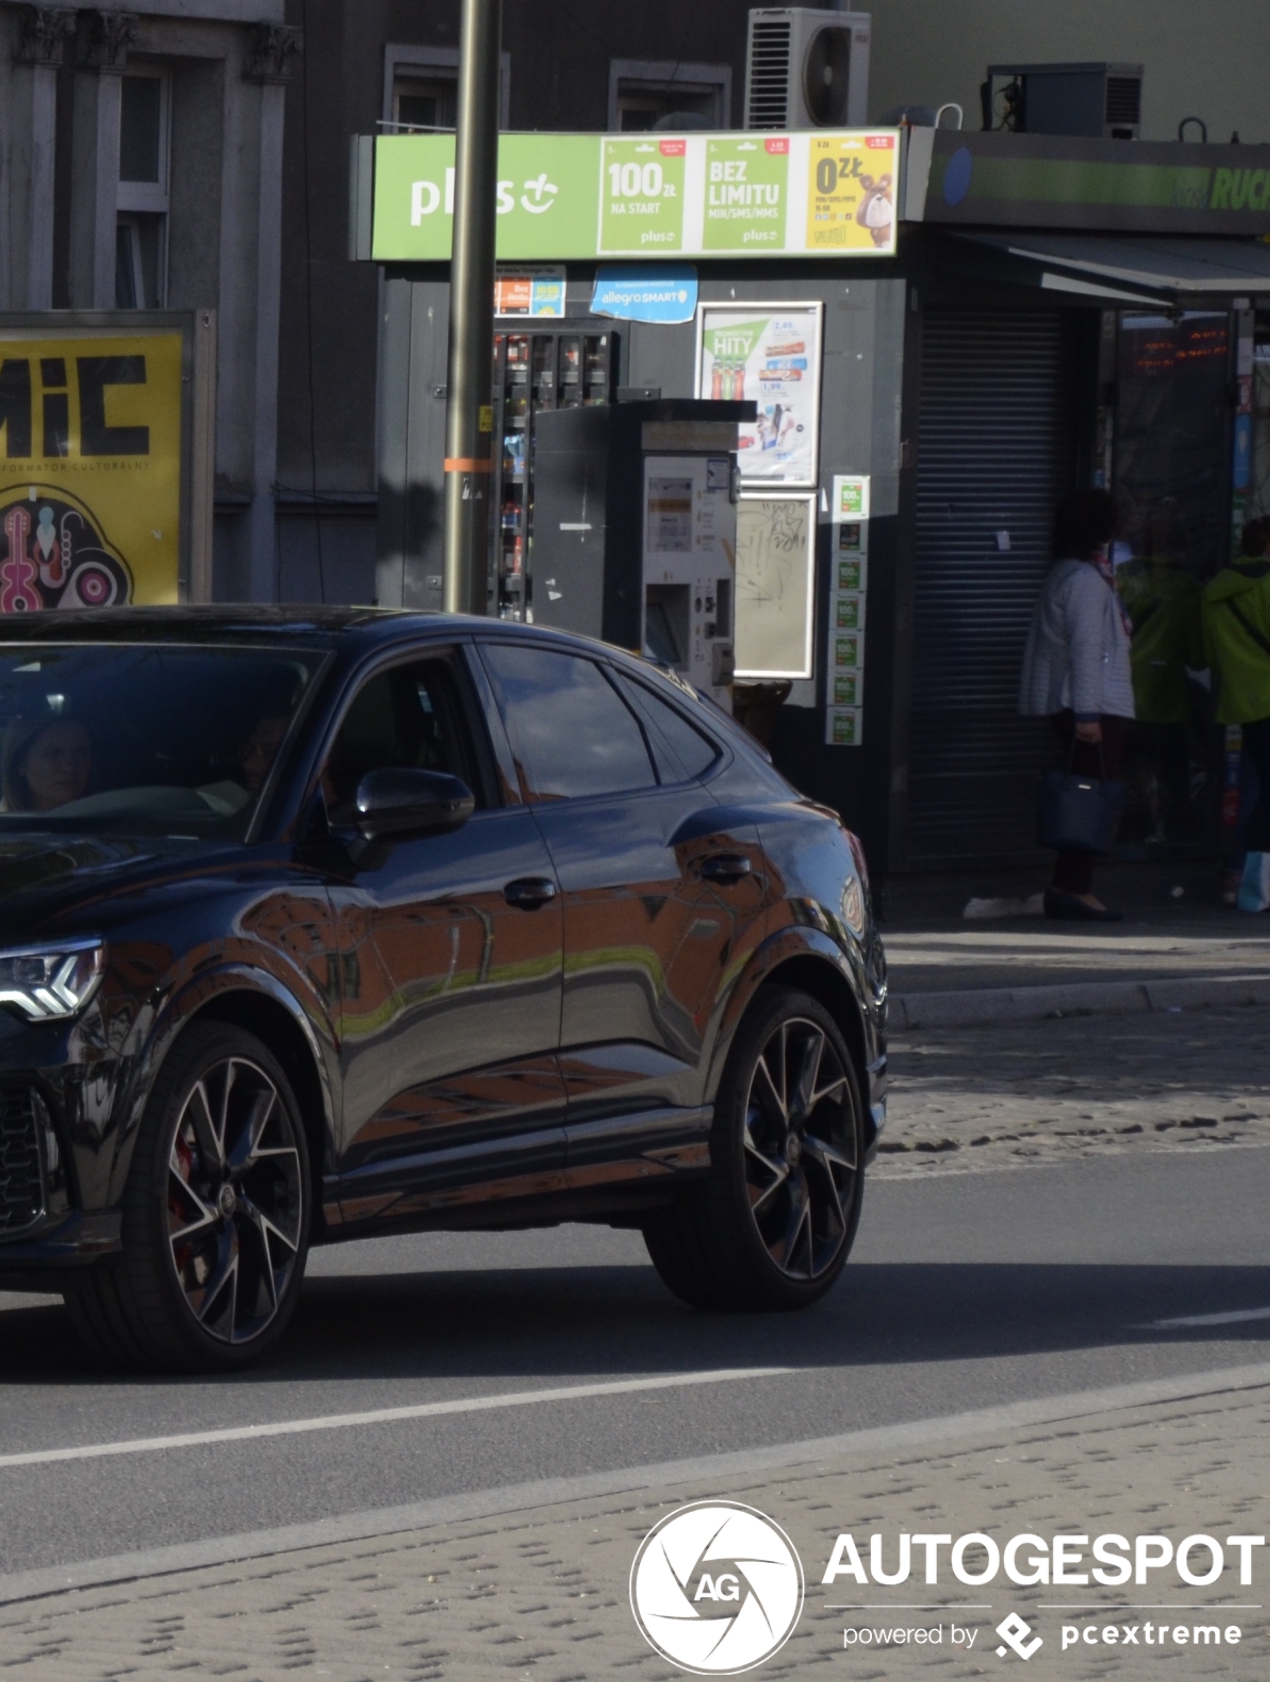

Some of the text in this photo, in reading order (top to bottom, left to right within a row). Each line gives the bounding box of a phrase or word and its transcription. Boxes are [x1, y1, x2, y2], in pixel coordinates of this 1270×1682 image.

[710, 161, 747, 182] BEZ
[411, 167, 515, 226] pls
[709, 184, 779, 205] LIMITU
[611, 202, 661, 214] NA START
[708, 207, 779, 220] MIN/SMS/MMS
[641, 230, 666, 244] plus
[743, 230, 769, 243] plus
[602, 290, 677, 306] allegro SMART
[714, 337, 754, 355] HITY
[72, 461, 149, 472] CULTURALNY
